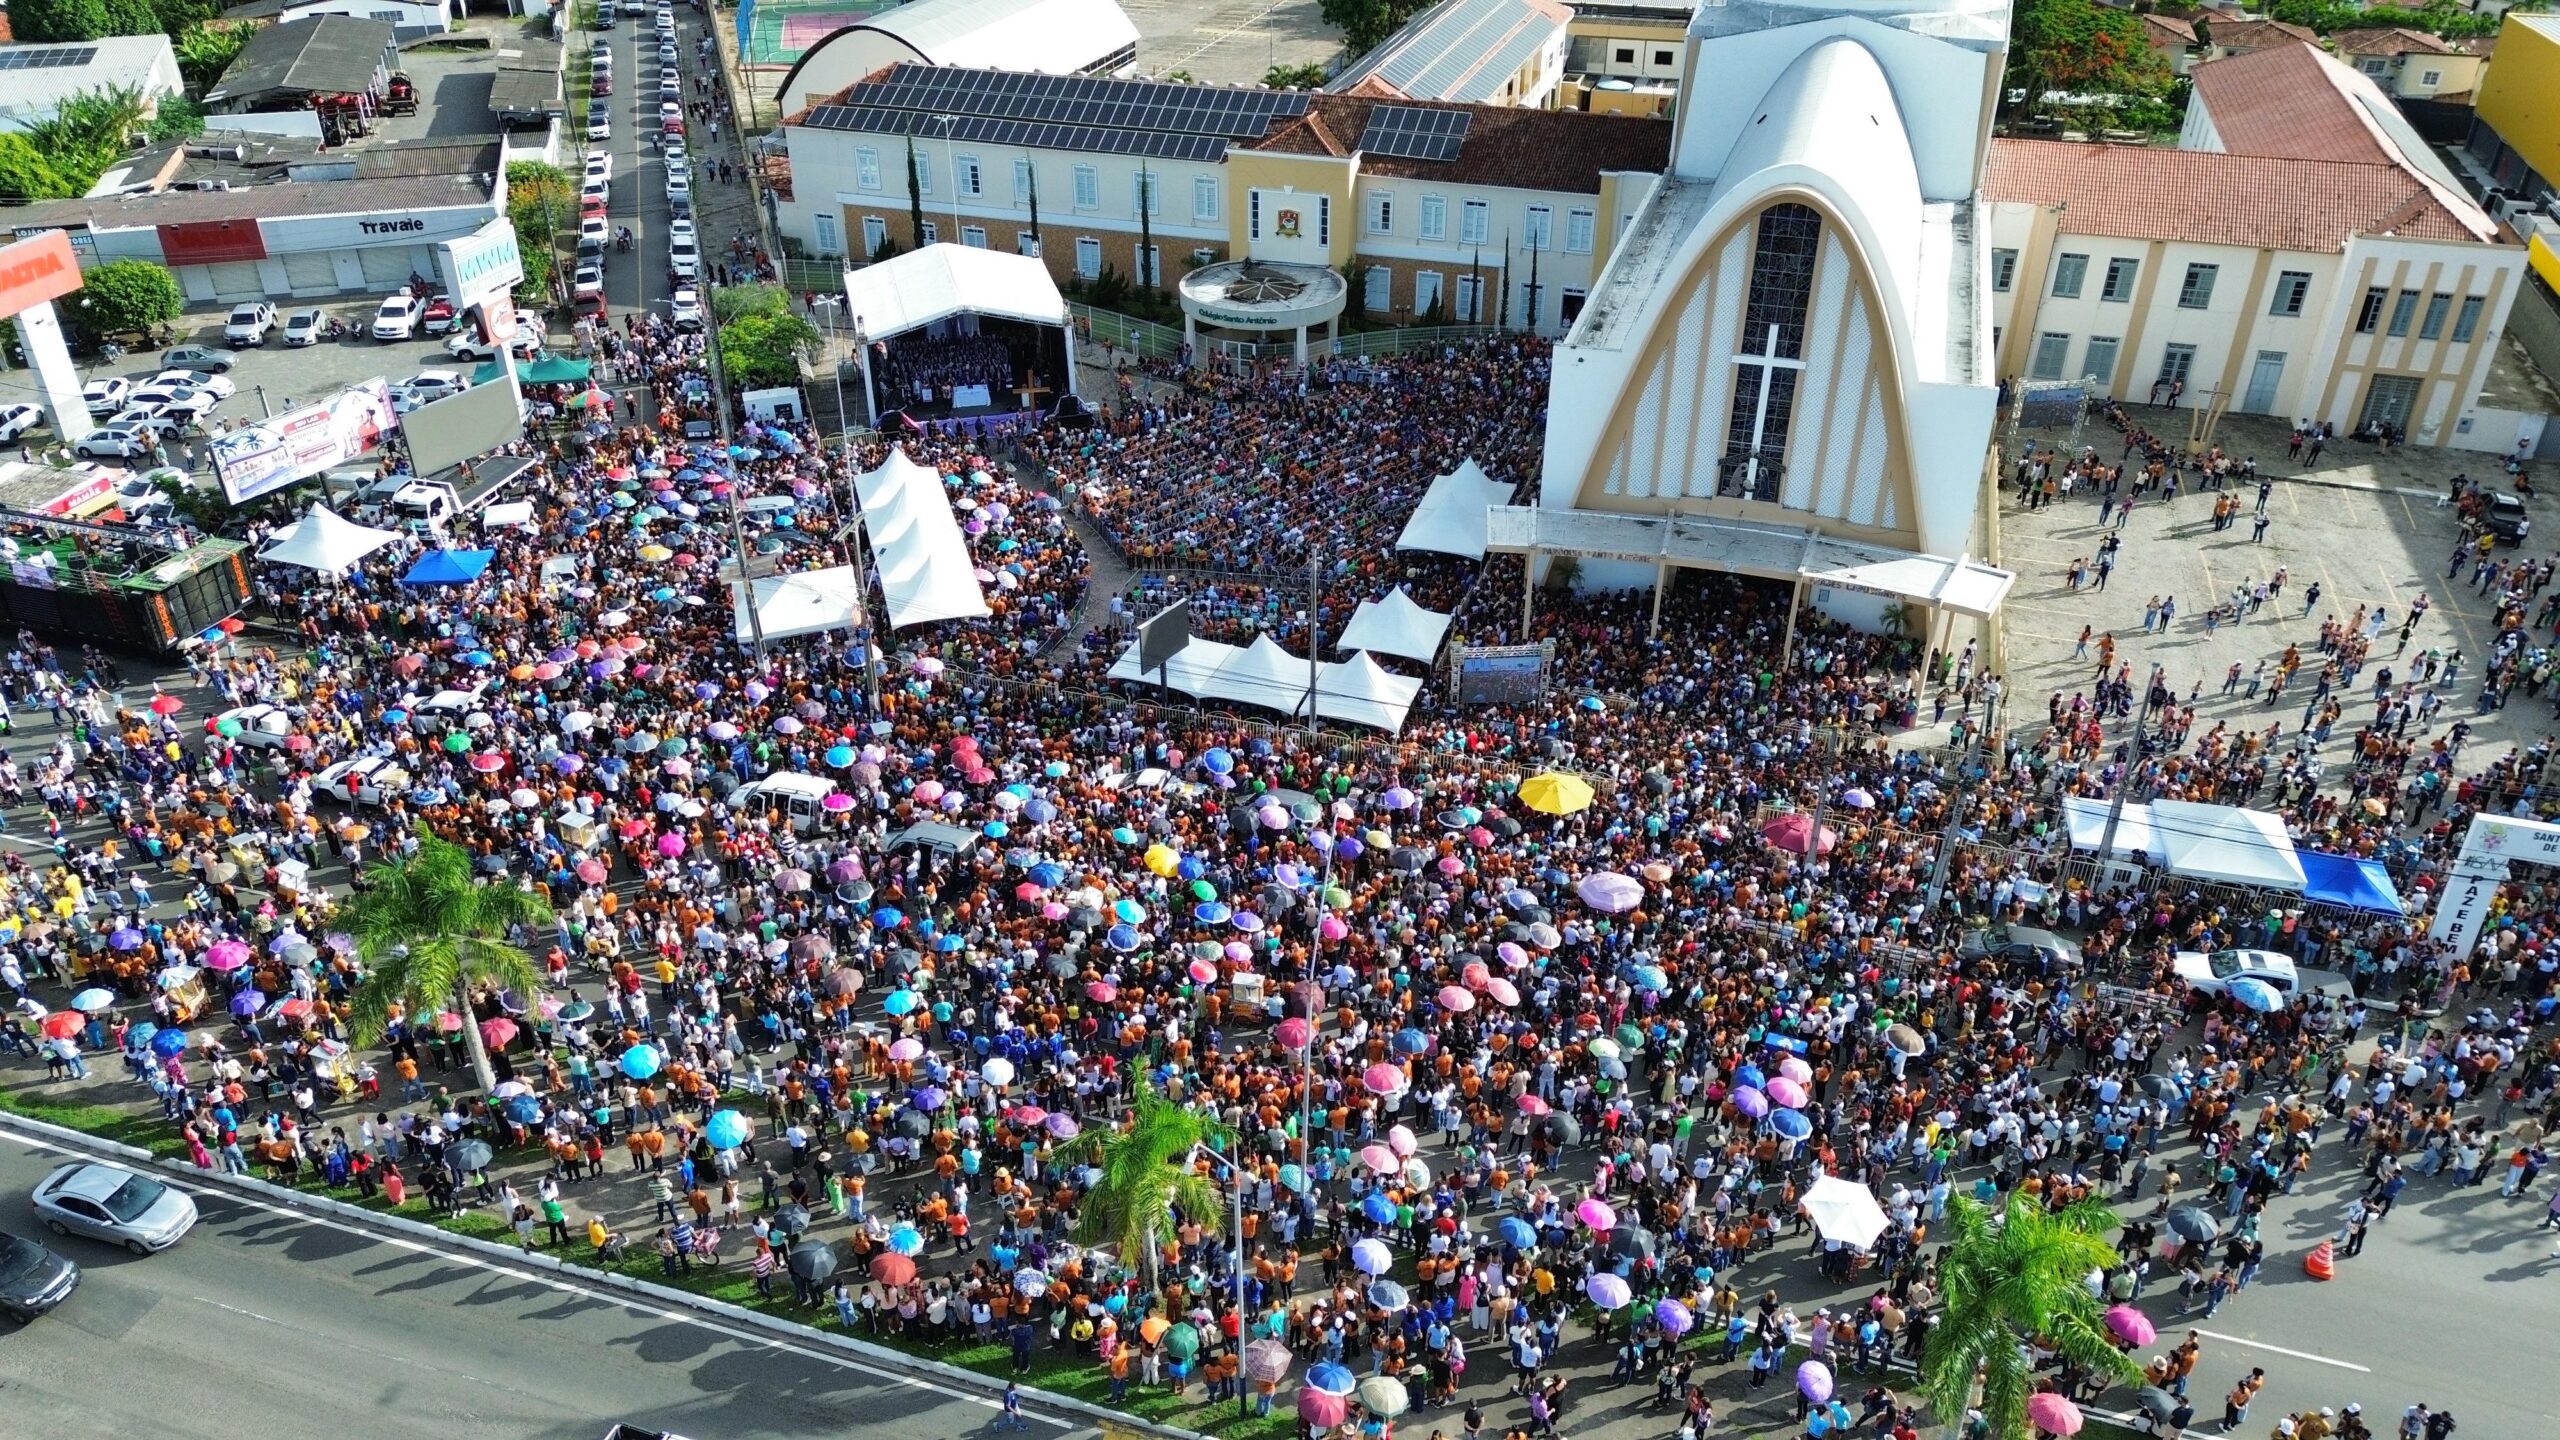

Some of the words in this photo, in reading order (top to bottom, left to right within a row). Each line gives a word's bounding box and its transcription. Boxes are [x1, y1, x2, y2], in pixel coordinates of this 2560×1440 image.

[1224, 315, 1245, 323] Santo
[2543, 843, 2557, 853] DE
[2461, 875, 2484, 907] PAZ
[2456, 909, 2470, 920] E
